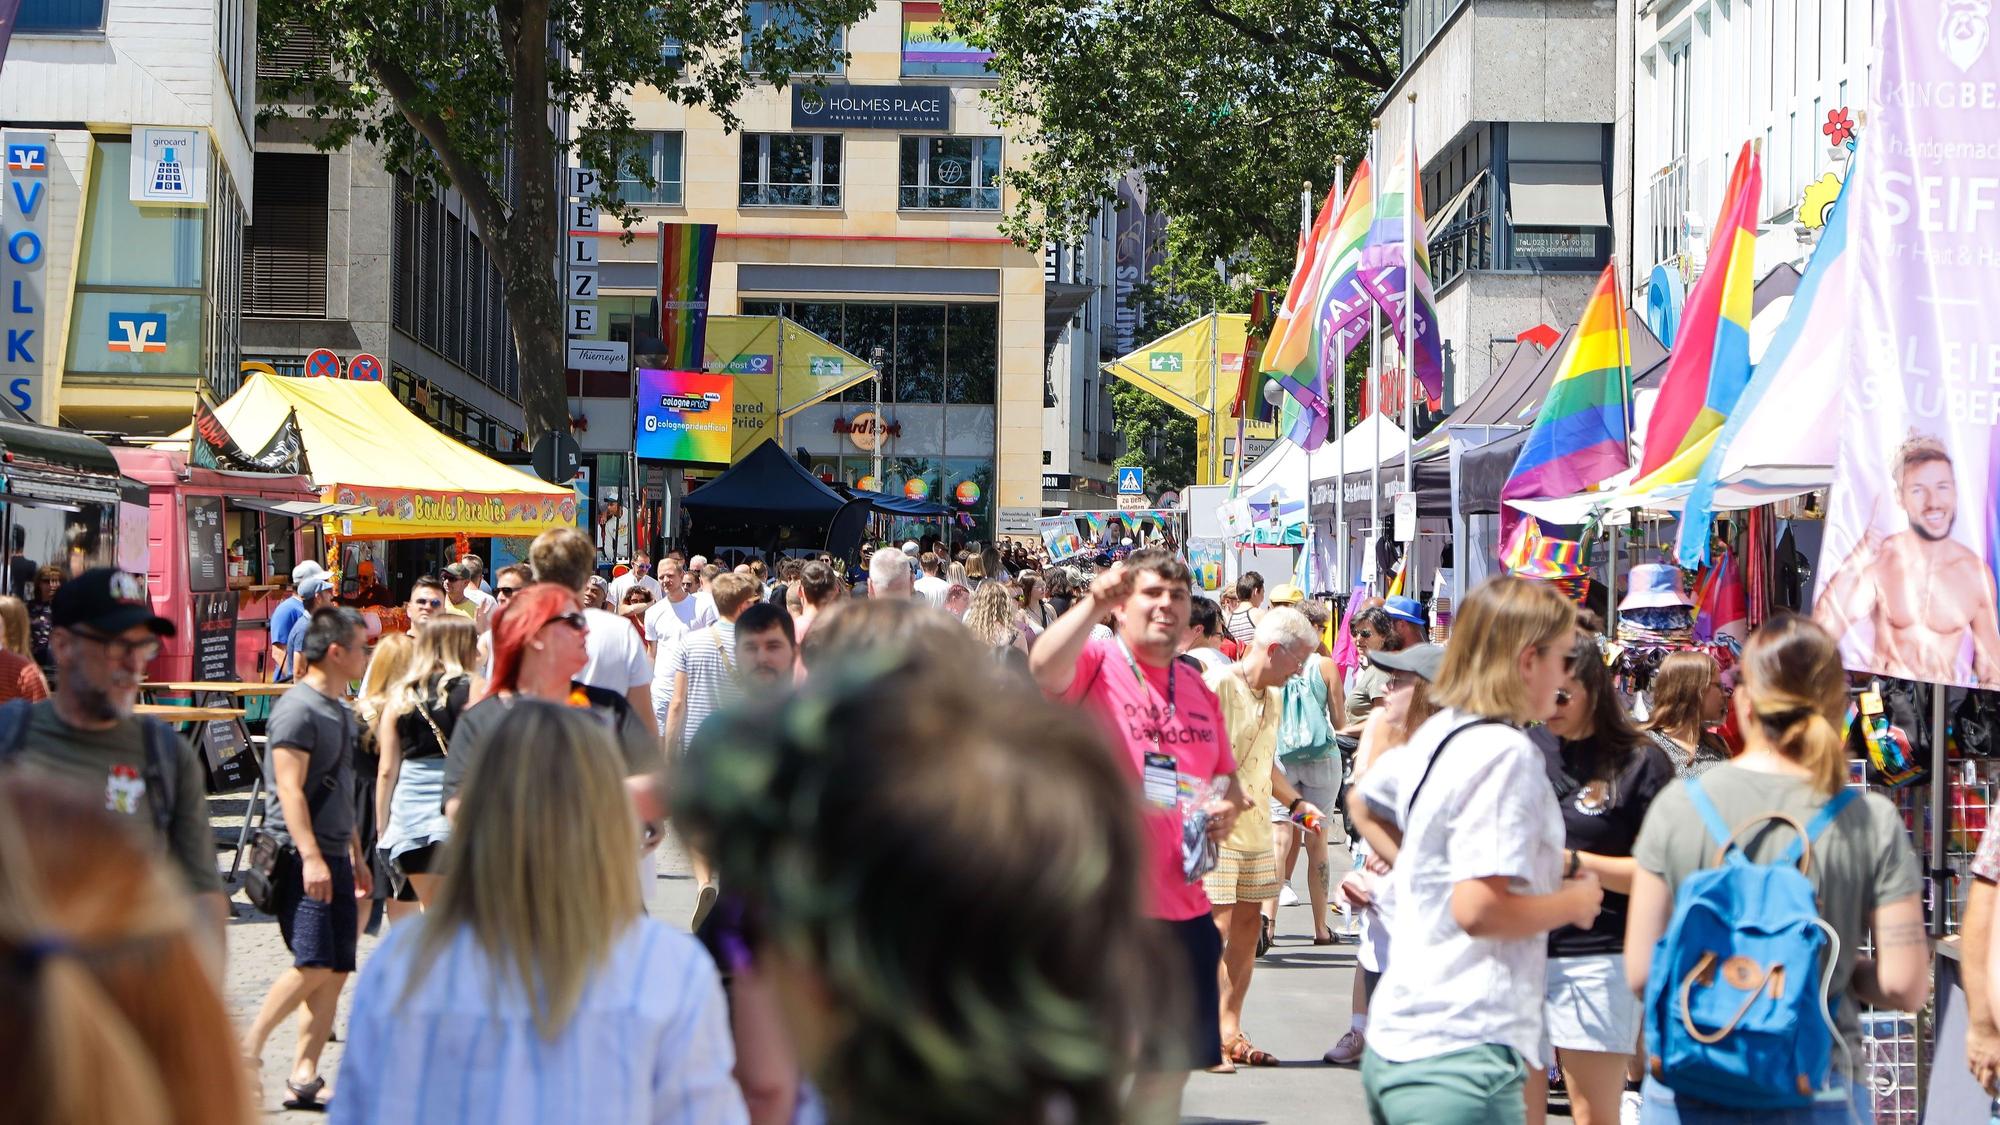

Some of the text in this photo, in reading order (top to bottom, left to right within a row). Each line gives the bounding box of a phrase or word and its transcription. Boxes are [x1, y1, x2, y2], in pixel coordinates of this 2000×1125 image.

[1886, 80, 2000, 109] KINGBE
[830, 98, 939, 112] HOLMES PLACE
[153, 137, 186, 147] girocard
[575, 172, 594, 331] PELZE
[8, 181, 42, 412] VOLKS
[578, 350, 625, 364] Thiemeyer
[730, 361, 747, 369] Post
[456, 496, 506, 521] Paradies
